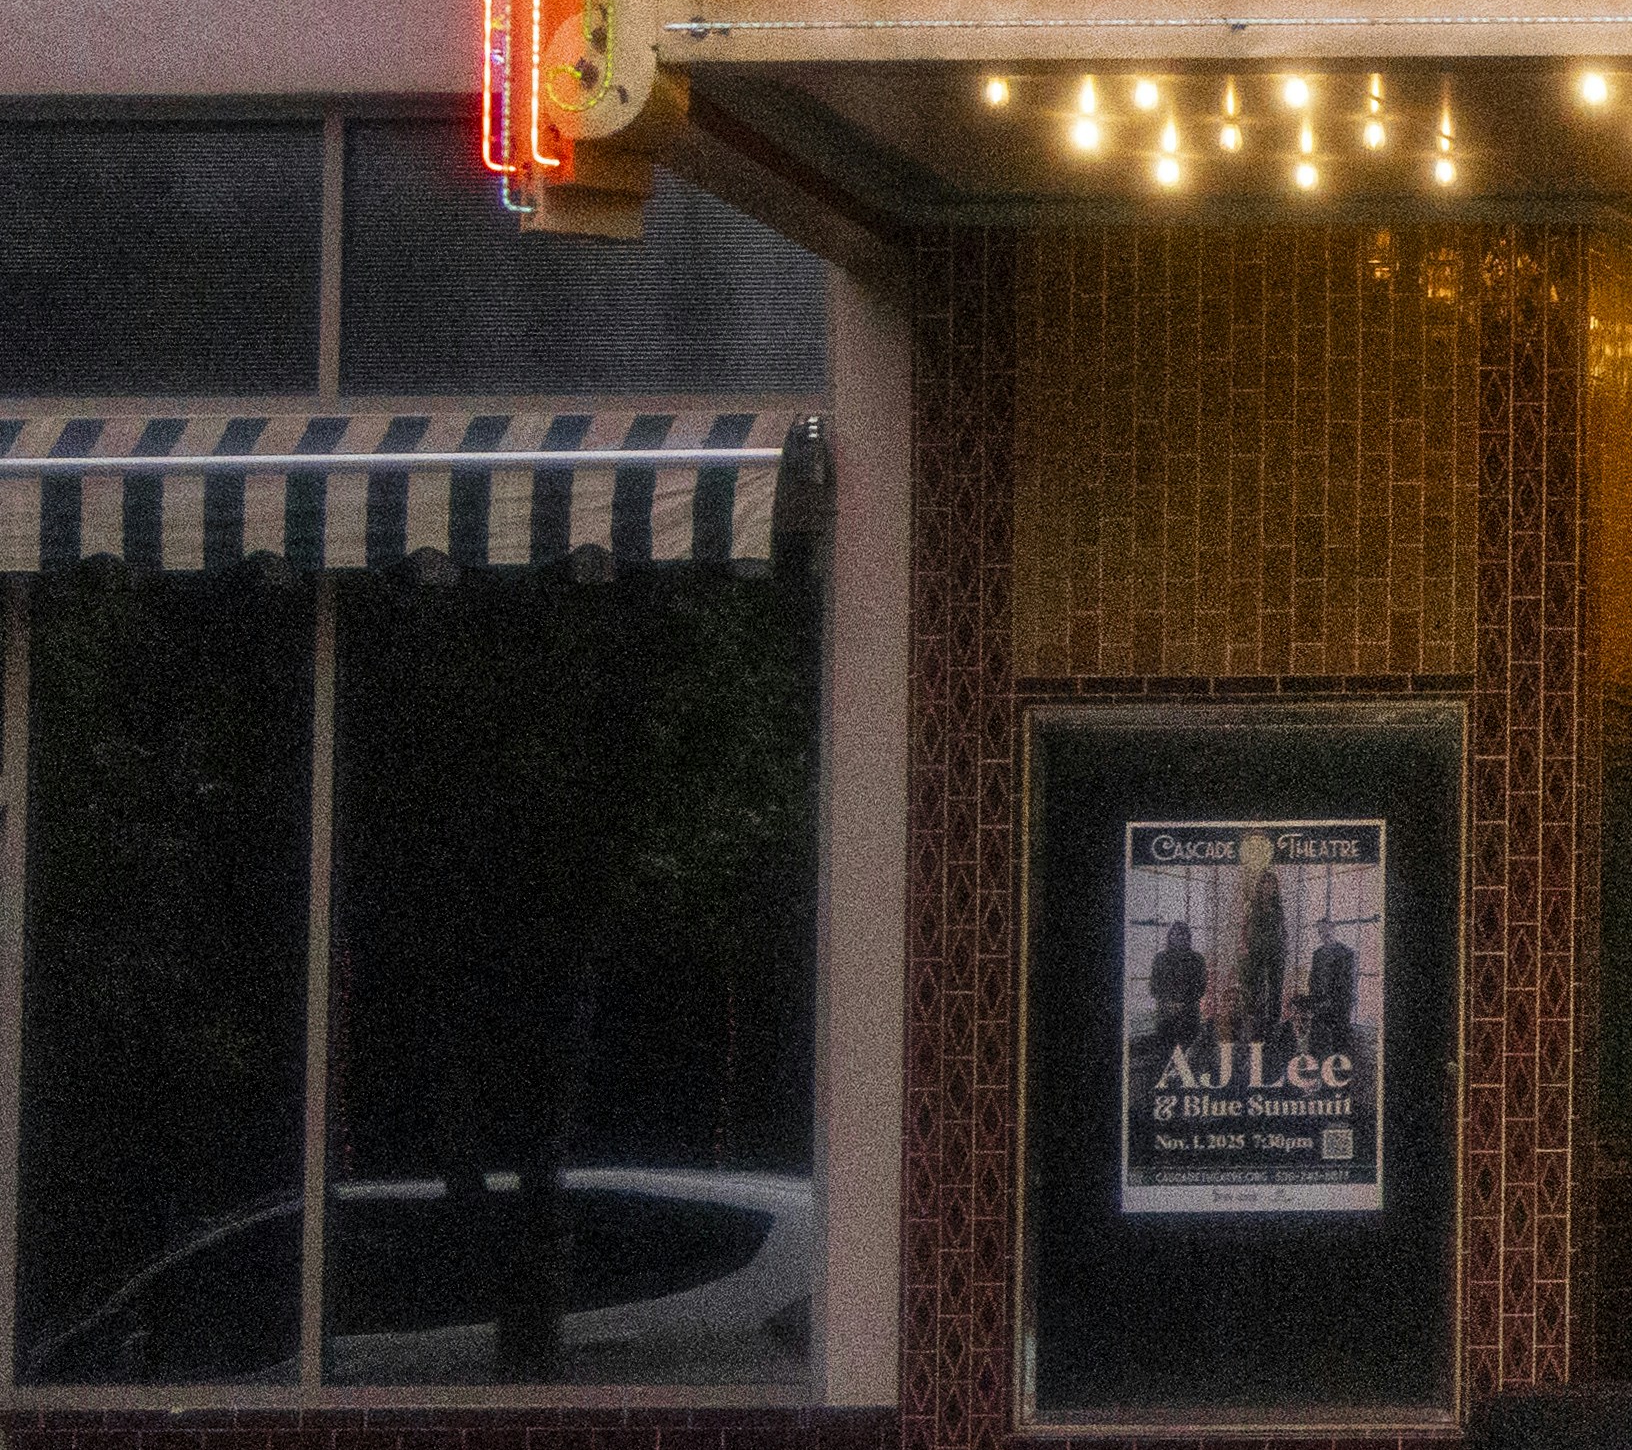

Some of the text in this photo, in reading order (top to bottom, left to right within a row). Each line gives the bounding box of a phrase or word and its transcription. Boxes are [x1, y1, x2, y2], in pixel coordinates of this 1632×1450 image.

[1150, 832, 1360, 861] CASCADE THEATRE
[1154, 1042, 1353, 1090] AJ Lee
[1154, 1092, 1352, 1121] & Blue Summit
[1207, 1134, 1245, 1149] 2025
